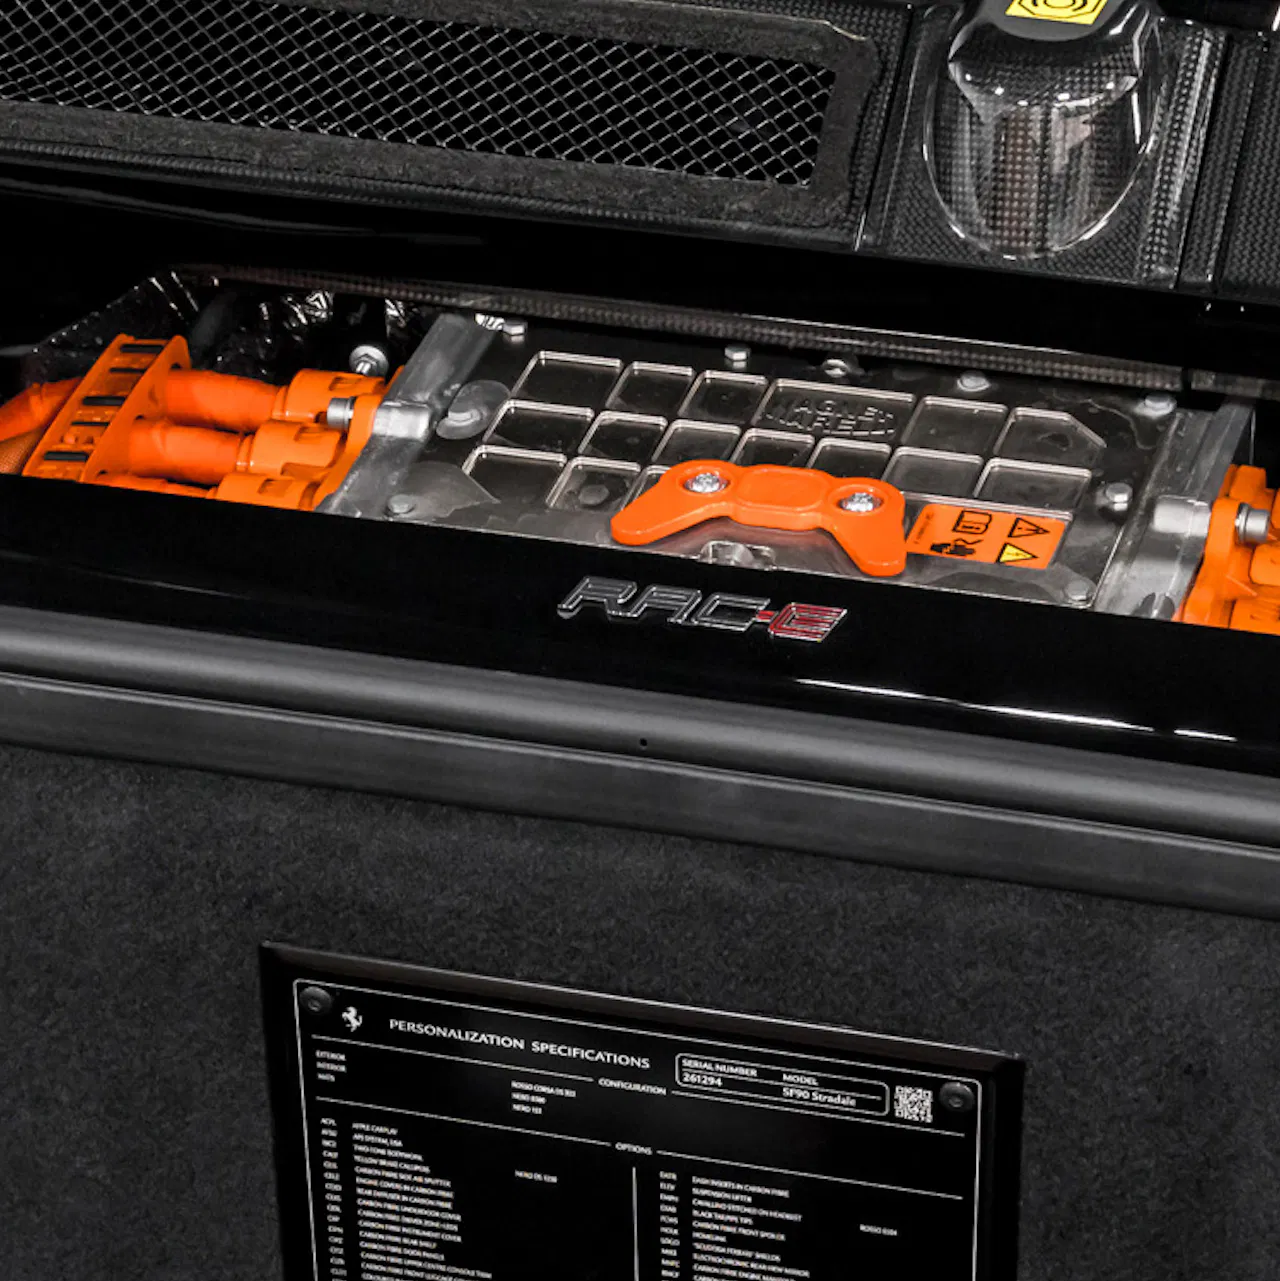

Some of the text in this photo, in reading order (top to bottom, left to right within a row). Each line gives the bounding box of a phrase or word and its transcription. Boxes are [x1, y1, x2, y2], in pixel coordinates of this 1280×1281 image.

[390, 1019, 651, 1069] PERSONALIZATION SPECIFICATIONS
[682, 1058, 758, 1077] SERIAL NUMBER
[598, 1078, 666, 1096] CONFIGURATION
[683, 1072, 723, 1087] 261294
[782, 1073, 819, 1086] MODEL
[782, 1087, 857, 1108] SF90 Stradale
[615, 1142, 652, 1156] OPTIONS
